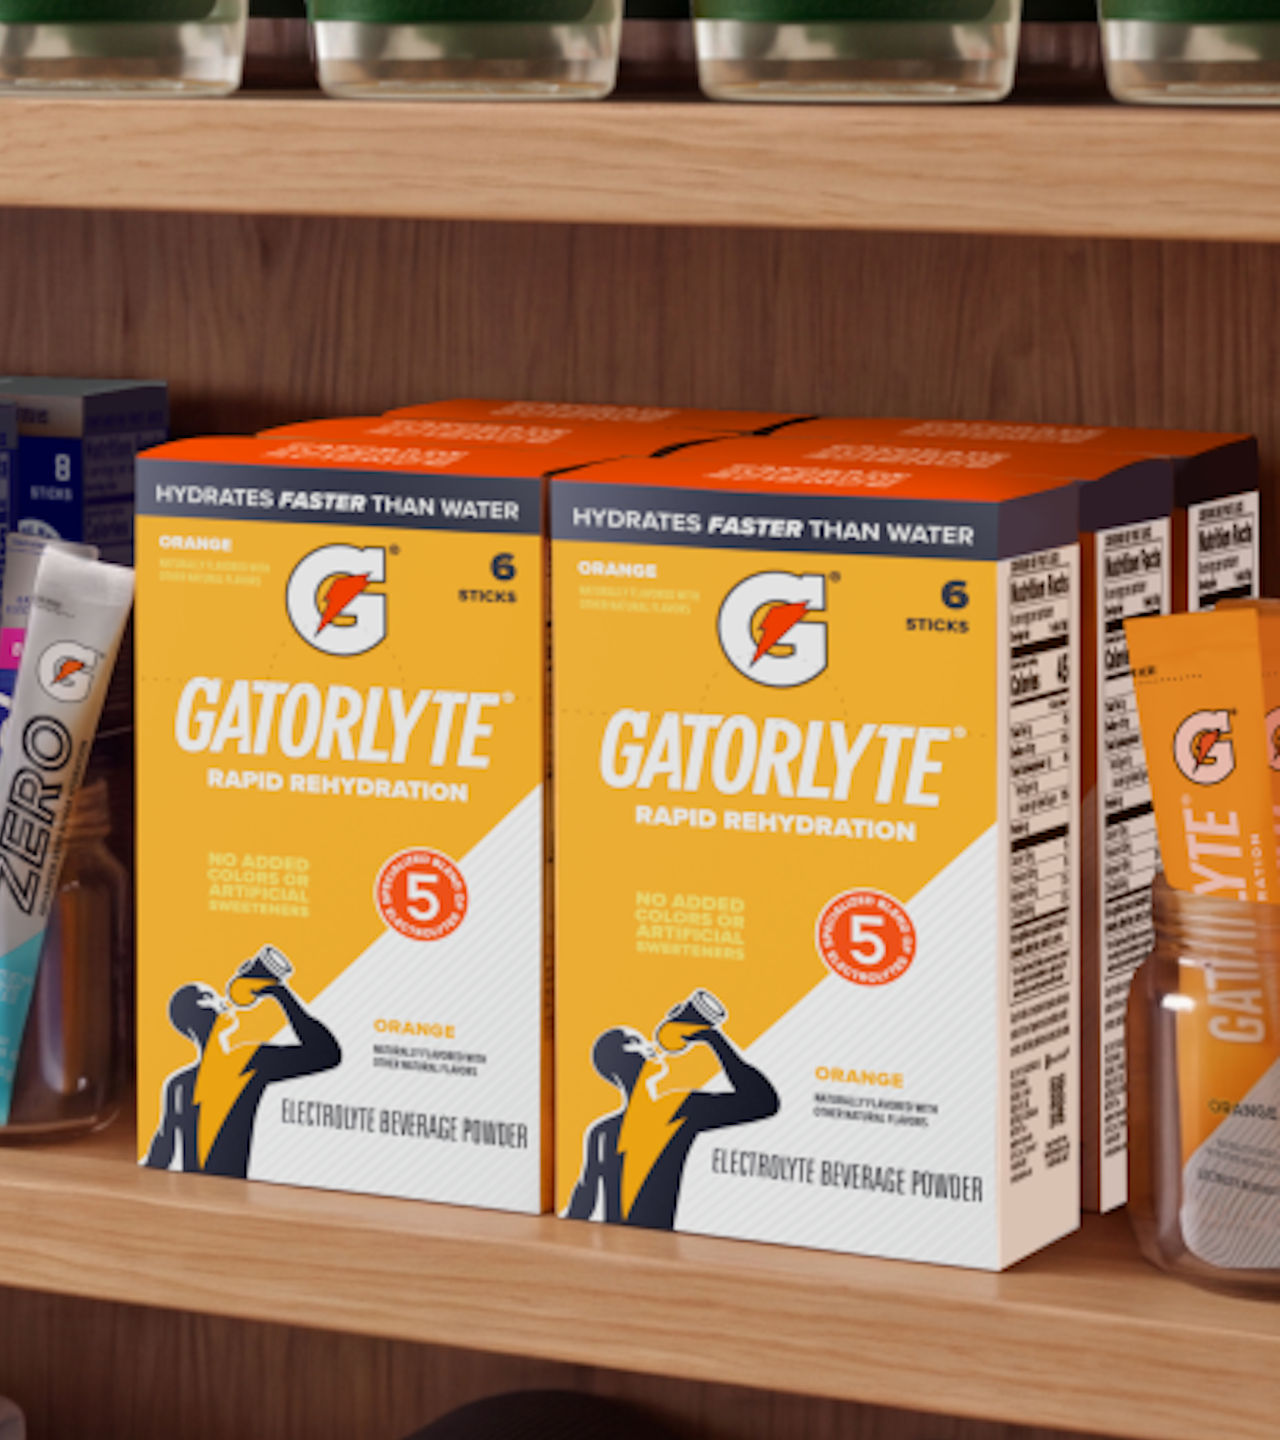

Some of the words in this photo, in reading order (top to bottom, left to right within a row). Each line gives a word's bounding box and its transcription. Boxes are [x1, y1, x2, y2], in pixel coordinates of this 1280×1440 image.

[53, 453, 71, 482] 8
[155, 483, 274, 509] HYDRATES
[279, 489, 367, 514] FASTER
[371, 494, 435, 518] THAN
[441, 498, 519, 521] WATER
[572, 507, 701, 535] HYDRATES
[708, 516, 804, 539] FASTER
[809, 521, 880, 542] THAN
[886, 524, 974, 546] WATER
[158, 535, 233, 553] ORANGE
[490, 552, 517, 582] 6
[578, 561, 657, 579] ORANGE
[458, 589, 518, 604] STICKS
[941, 579, 969, 609] 6
[906, 617, 969, 633] STICKS
[207, 768, 284, 791] RAPID
[290, 772, 469, 803] REHYDRATION
[635, 804, 717, 829] RAPID
[724, 808, 916, 842] REHYDRATION
[207, 851, 237, 869] NO
[241, 853, 310, 873] ADDED
[207, 867, 278, 886] COLORS
[283, 872, 310, 888] OR
[207, 883, 310, 904] ARTIFICIAL
[407, 872, 440, 921] 5
[635, 891, 667, 909] NO
[672, 893, 745, 913] ADDED
[207, 899, 310, 918] SWEETENERS
[634, 908, 711, 928] COLORS
[717, 913, 745, 929] OR
[636, 924, 745, 945] ARTIFICIAL
[851, 914, 884, 964] 5
[636, 941, 745, 961] SWEETENERS
[373, 1018, 456, 1039] ORANGE
[815, 1065, 904, 1089] ORANGE
[281, 1097, 376, 1134] ELECTROLYTE
[380, 1107, 458, 1143] BEVERAGE
[462, 1116, 529, 1149] POWDER
[711, 1147, 815, 1185] ELECTROLYTE
[820, 1160, 905, 1195] BEVERAGE
[910, 1169, 983, 1204] POWDER
